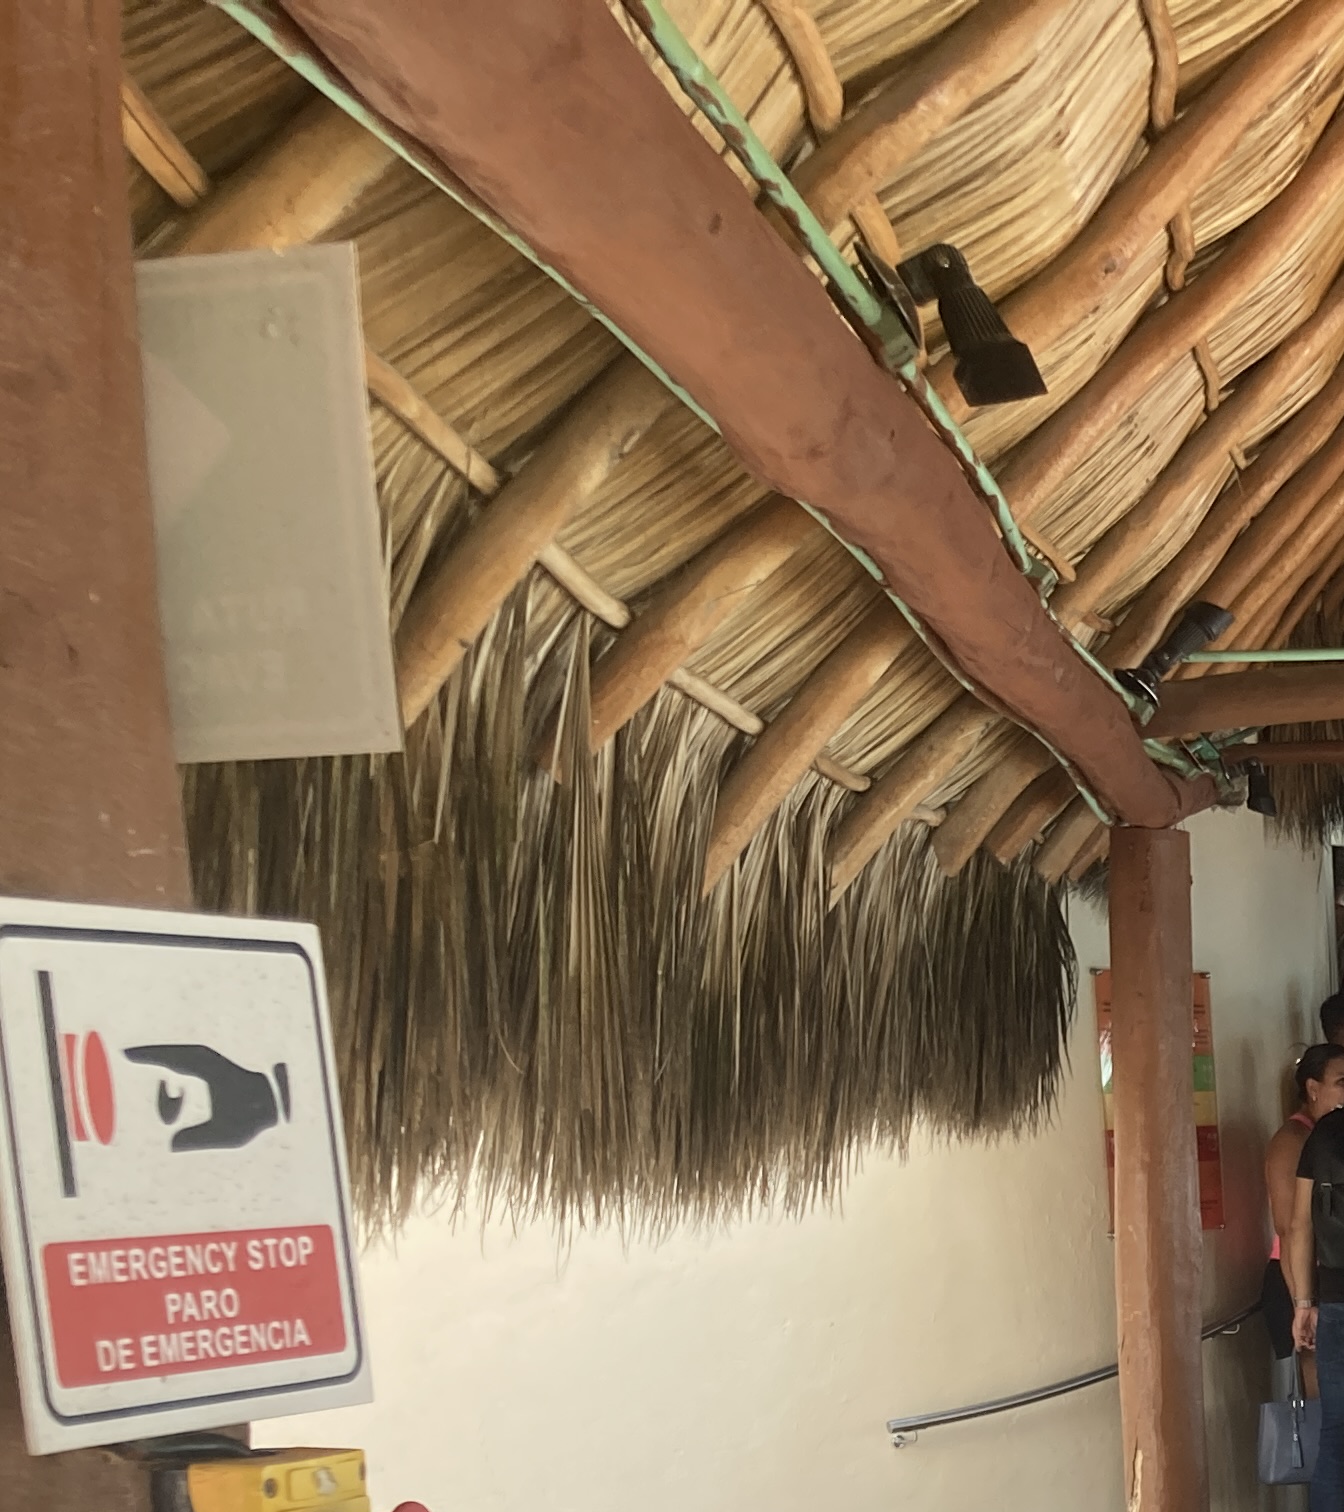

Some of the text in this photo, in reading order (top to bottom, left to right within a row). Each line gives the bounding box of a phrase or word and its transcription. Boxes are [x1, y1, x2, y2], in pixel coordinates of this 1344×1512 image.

[67, 1235, 314, 1287] EMERGENCY STOP
[164, 1287, 240, 1325] PARO
[95, 1318, 312, 1373] DE EMERGENCIA
